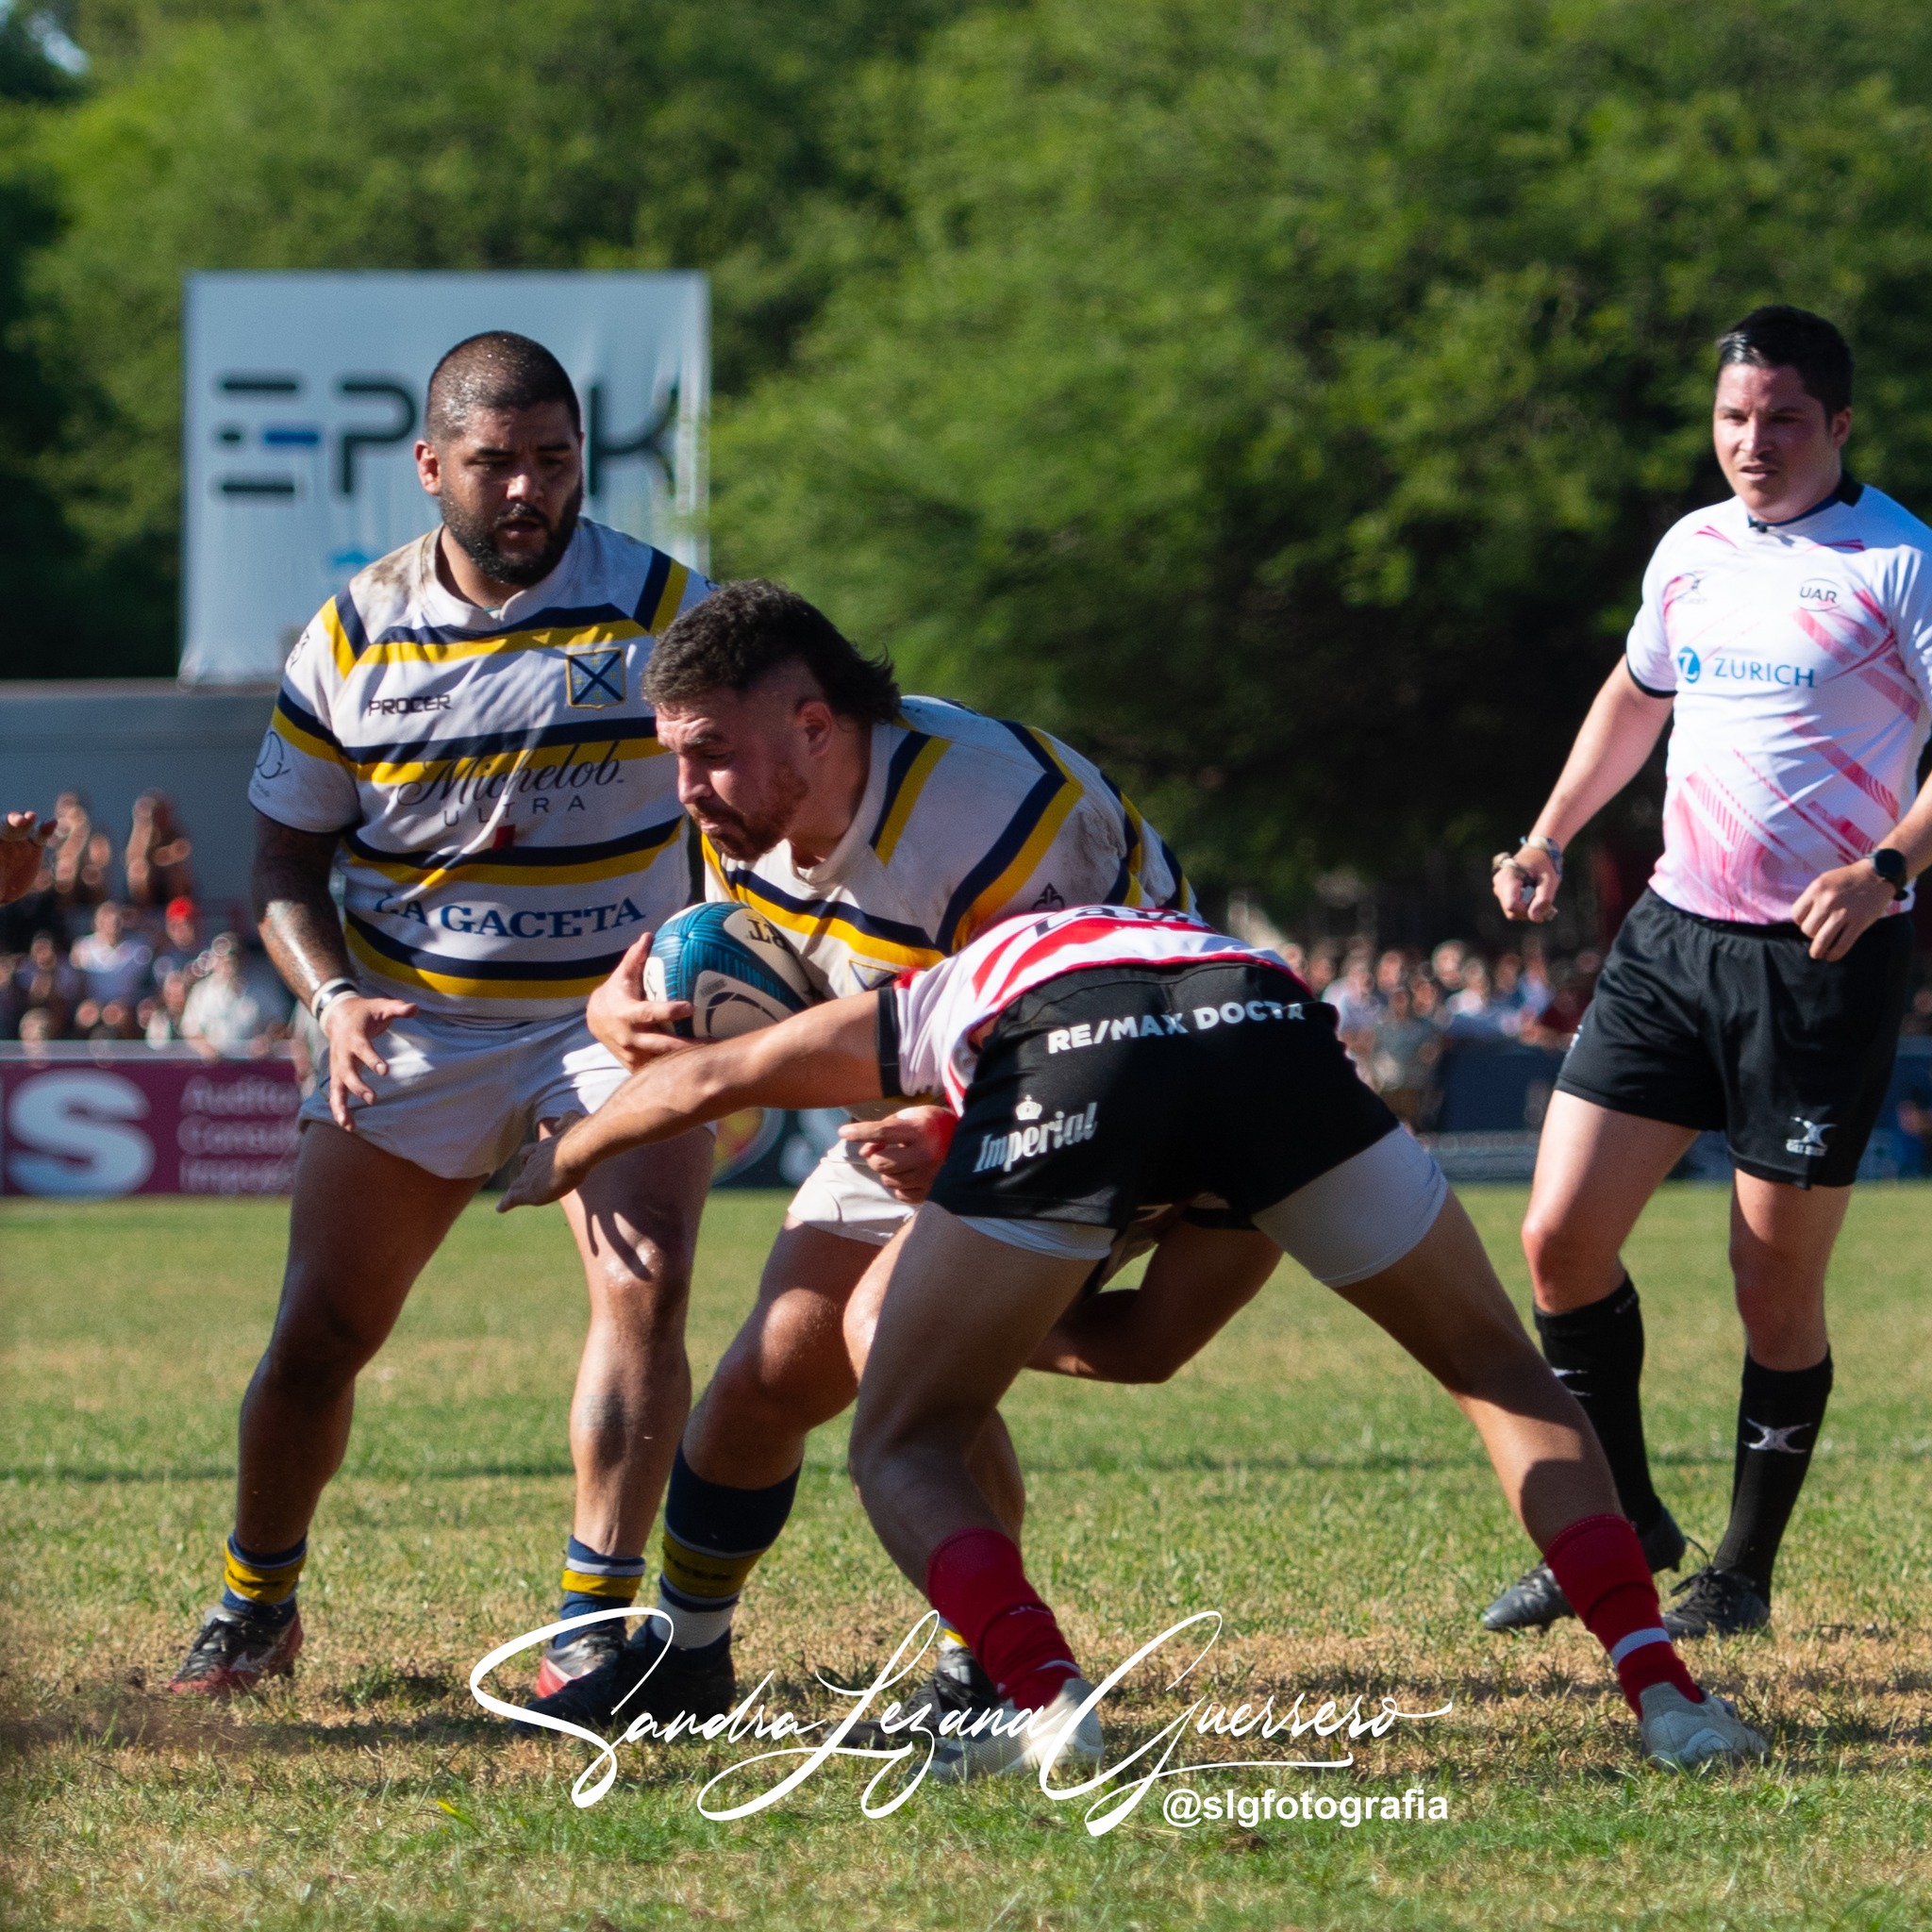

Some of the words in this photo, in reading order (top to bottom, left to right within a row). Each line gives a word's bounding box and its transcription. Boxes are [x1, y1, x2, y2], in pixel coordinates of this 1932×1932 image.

[220, 379, 681, 496] EPK
[1799, 586, 1838, 604] UAR
[1713, 657, 1815, 689] ZURICH
[368, 693, 451, 717] PROCER
[396, 740, 621, 807] Michelob
[443, 794, 586, 827] ULTRA
[441, 896, 646, 939] GACETA
[1047, 1012, 1189, 1055] RE/MAX
[973, 1101, 1099, 1174] Imperial
